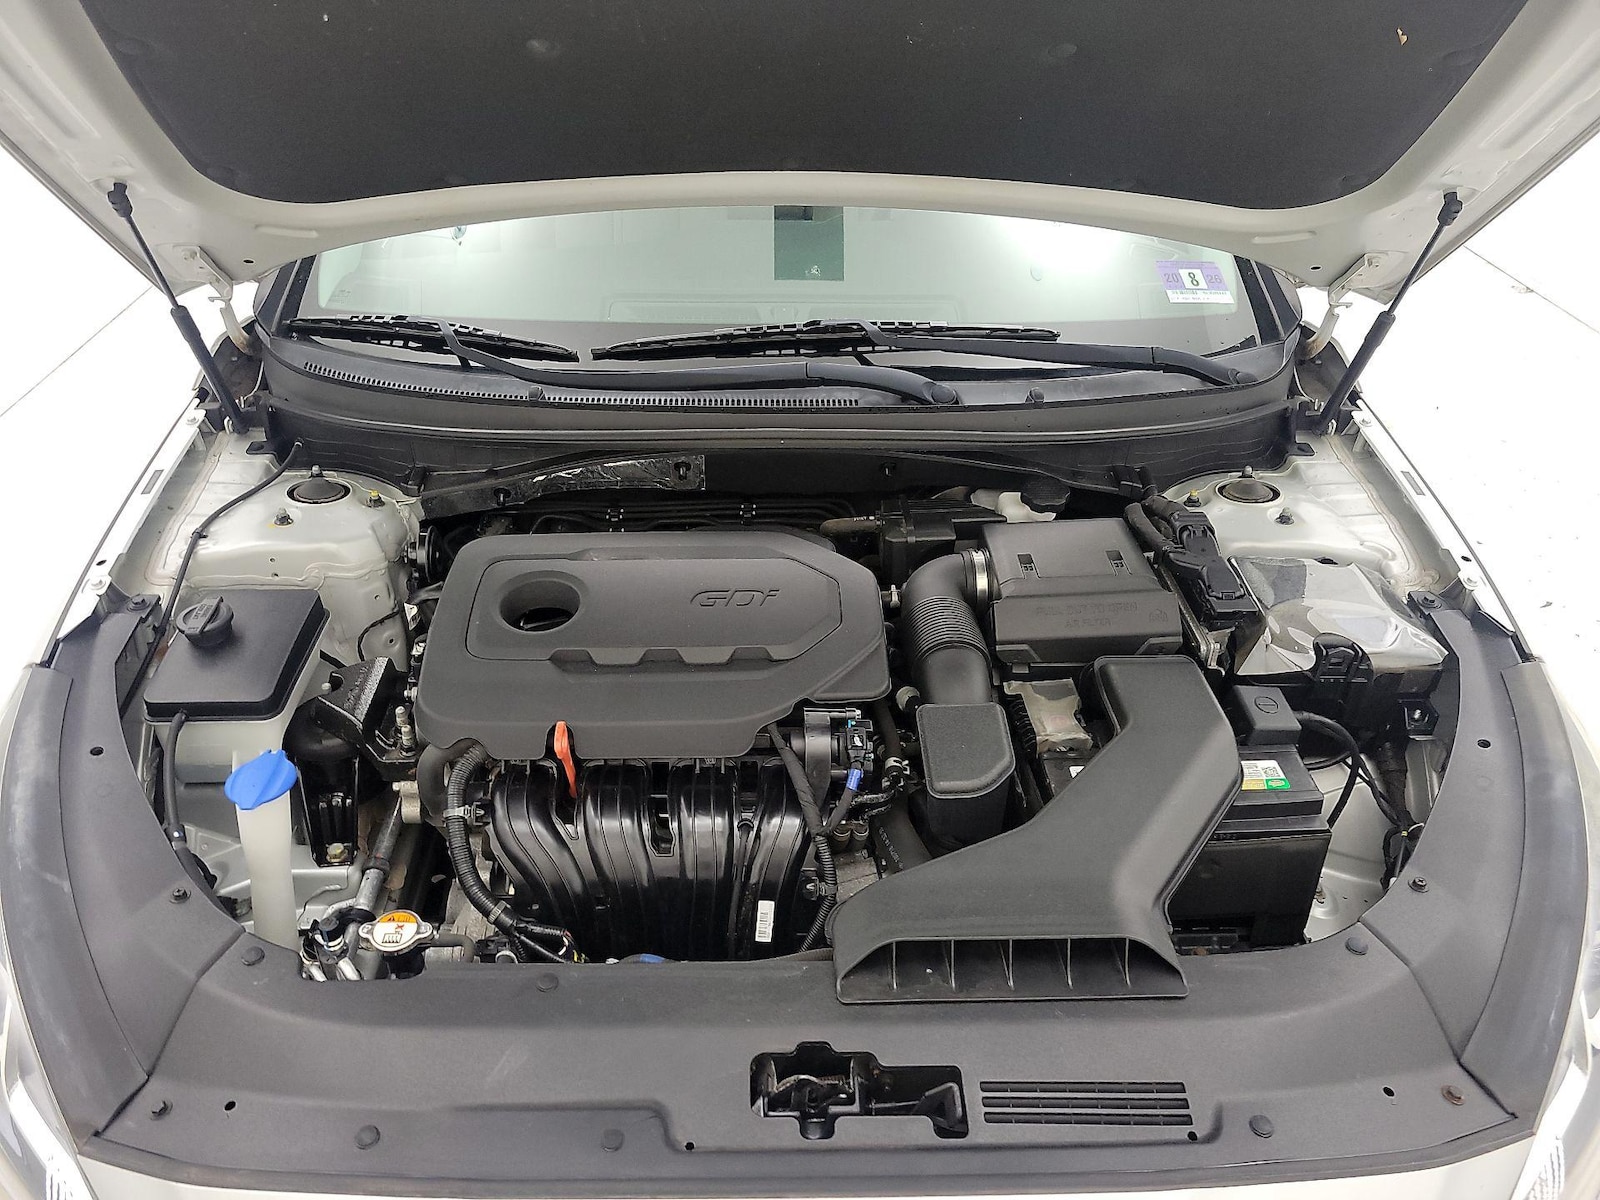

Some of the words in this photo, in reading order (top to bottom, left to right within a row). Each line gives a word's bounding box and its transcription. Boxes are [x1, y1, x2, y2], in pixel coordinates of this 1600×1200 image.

[1164, 272, 1179, 283] 20
[1188, 272, 1199, 287] 8
[1206, 274, 1222, 284] 26
